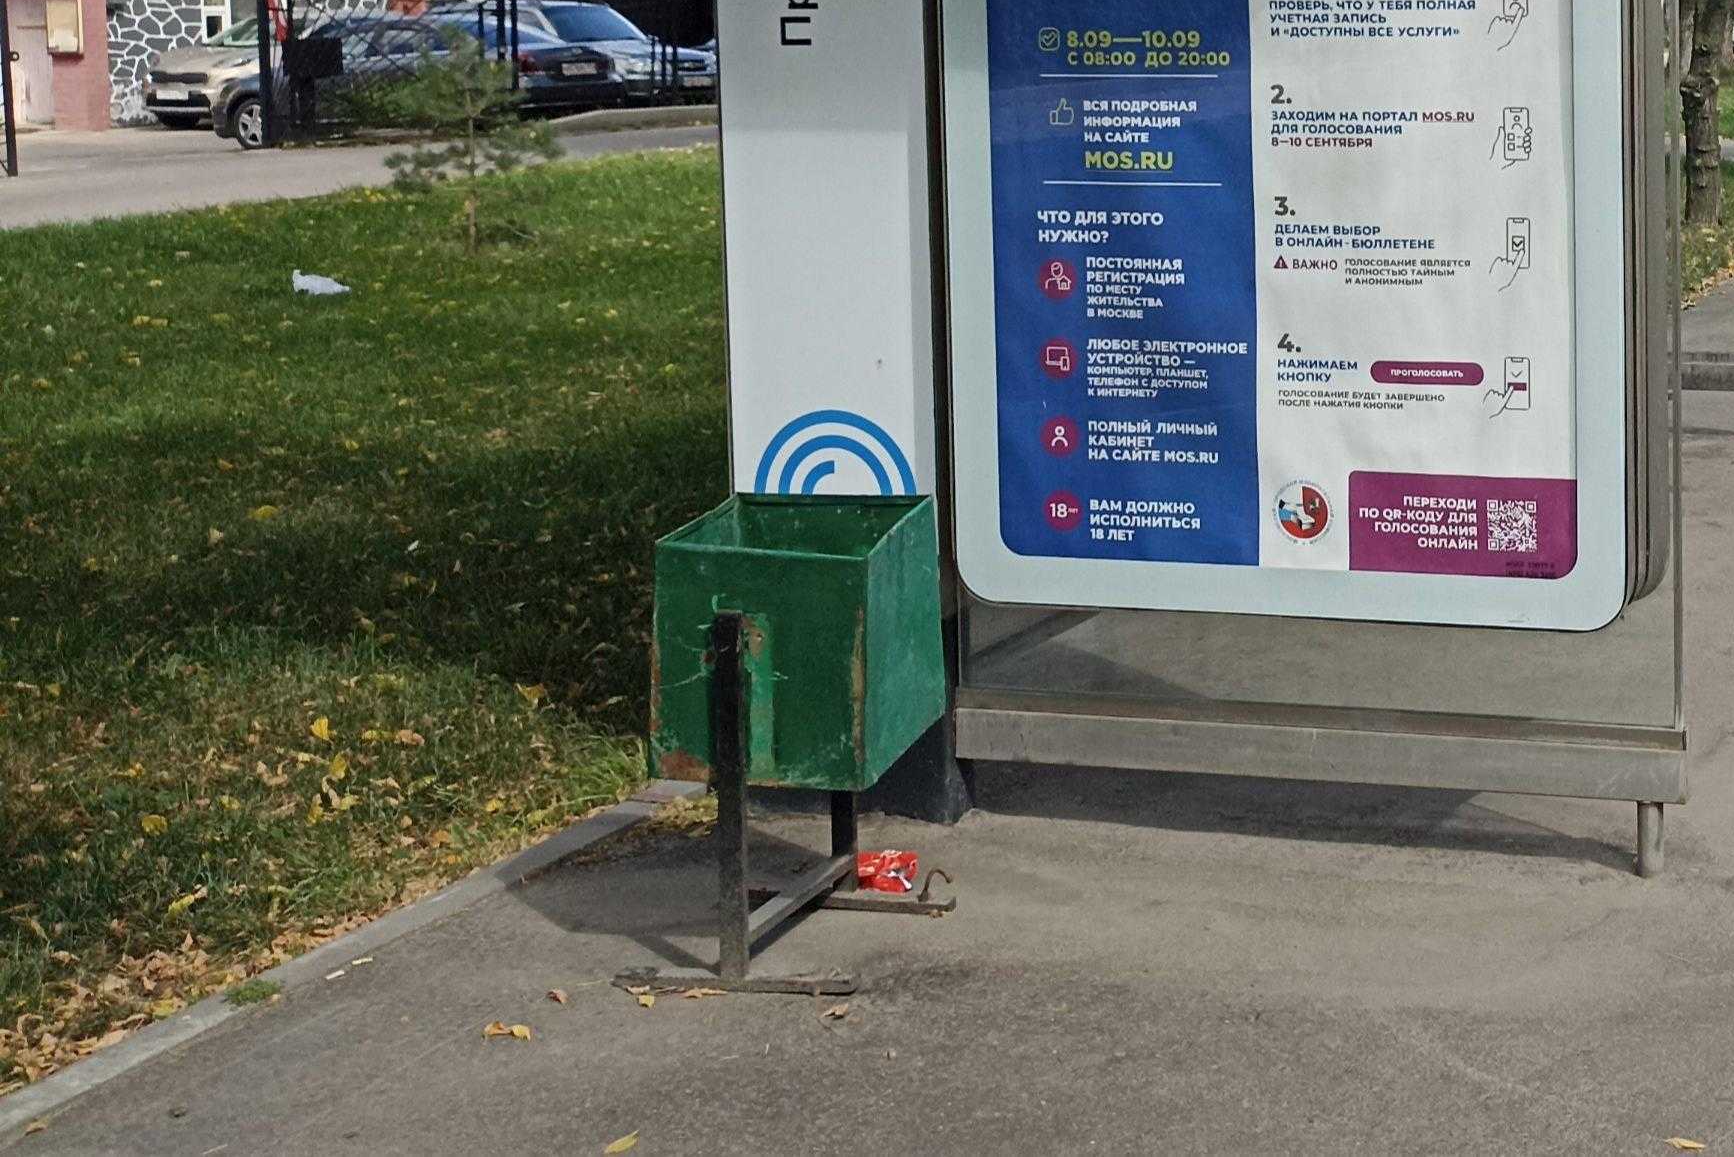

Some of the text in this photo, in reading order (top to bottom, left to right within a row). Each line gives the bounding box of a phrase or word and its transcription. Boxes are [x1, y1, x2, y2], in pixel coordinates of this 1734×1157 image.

[1269, 0, 1476, 12] ПРОВЕРЬ, ЧТО У ТЕБЯ ПОЛНАЯ
[1270, 13, 1387, 24] УЧЕТНАЯ ЗАПИСЬ
[1271, 26, 1460, 38] И «ДОСТУПНЫ ВСЕ УСЛУГИ»
[1068, 52, 1230, 67] С 08:00 ДО 20:00
[1270, 84, 1292, 104] 2.
[1083, 100, 1197, 113] ВСЯ ПОДРОБНАЯ
[1084, 116, 1181, 130] ИНФОРМАЦИЯ
[1272, 111, 1475, 123] ЗАХОДИМ НА ПОРТАЛ MOS.RU
[1271, 124, 1403, 135] ДЛЯ ГОЛОСОВАНИЯ
[1084, 130, 1149, 143] НА САЙТЕ
[1305, 137, 1373, 149] СЕНТЯБРЯ
[1085, 151, 1174, 170] MOS.RU
[1274, 196, 1296, 216] 3.
[1037, 210, 1163, 226] ЧТО ДЛЯ ЭТОГО
[1275, 224, 1381, 236] ДЕЛАЕМ ВЫБОР
[1038, 230, 1109, 243] НУЖНО?
[1275, 237, 1283, 247] В
[1086, 256, 1183, 270] ПОСТОЯННАЯ
[1292, 259, 1338, 270] ВАЖНО
[1345, 259, 1471, 267] ГОЛОСОВАНИЕ ЯВЛЯЕТСЯ
[1345, 267, 1455, 276] ПОЛНОСТЬЮ ТАЙНЫМ
[1086, 271, 1185, 286] РЕГИСТРАЦИЯ
[1087, 284, 1142, 295] ПО МЕСТУ
[1087, 297, 1163, 307] ЖИТЕЛЬСТВА
[1087, 308, 1144, 319] В МОСКВЕ
[1087, 339, 1248, 355] ЛЮБОЕ ЭЛЕКТРОННОЕ
[1277, 333, 1302, 352] 4.
[1088, 352, 1181, 366] УСТРОЙСТВО
[1278, 359, 1358, 370] НАЖИМАЕМ
[1087, 366, 1209, 379] КОМПЬЮТЕР, ПЛАНШЕТ,
[1278, 372, 1331, 383] КНОПКУ
[1391, 369, 1464, 378] ПРОГОЛОСОВАТЬ
[1088, 377, 1138, 386] ТЕЛЕФОН
[1151, 379, 1208, 389] ДОСТУПОМ
[1097, 389, 1158, 397] ИНТЕРНЕТУ
[1279, 390, 1445, 401] ГОЛОСОВАНИЕ БУДЕТ ЗАВЕРШЕНО
[1279, 399, 1310, 407] ПОСЛЕ
[1088, 420, 1217, 436] ПОЛНЫЙ ЛИЧНЫЙ
[1088, 436, 1154, 447] КАБИНЕТ
[1089, 448, 1219, 463] НА САЙТЕ MOS.RU
[1090, 500, 1195, 514] ВАМ ДОЛЖНО
[1403, 496, 1477, 510] ПЕРЕХОДИ
[1090, 515, 1200, 529] ИСПОЛНИТЬСЯ
[1359, 508, 1477, 524] ПО QR-КОДУ ДЛЯ
[1091, 529, 1134, 541] 18 ЛЕТ
[1374, 522, 1478, 537] ГОЛОСОВАНИЯ
[1418, 536, 1478, 550] ОНЛАЙН
